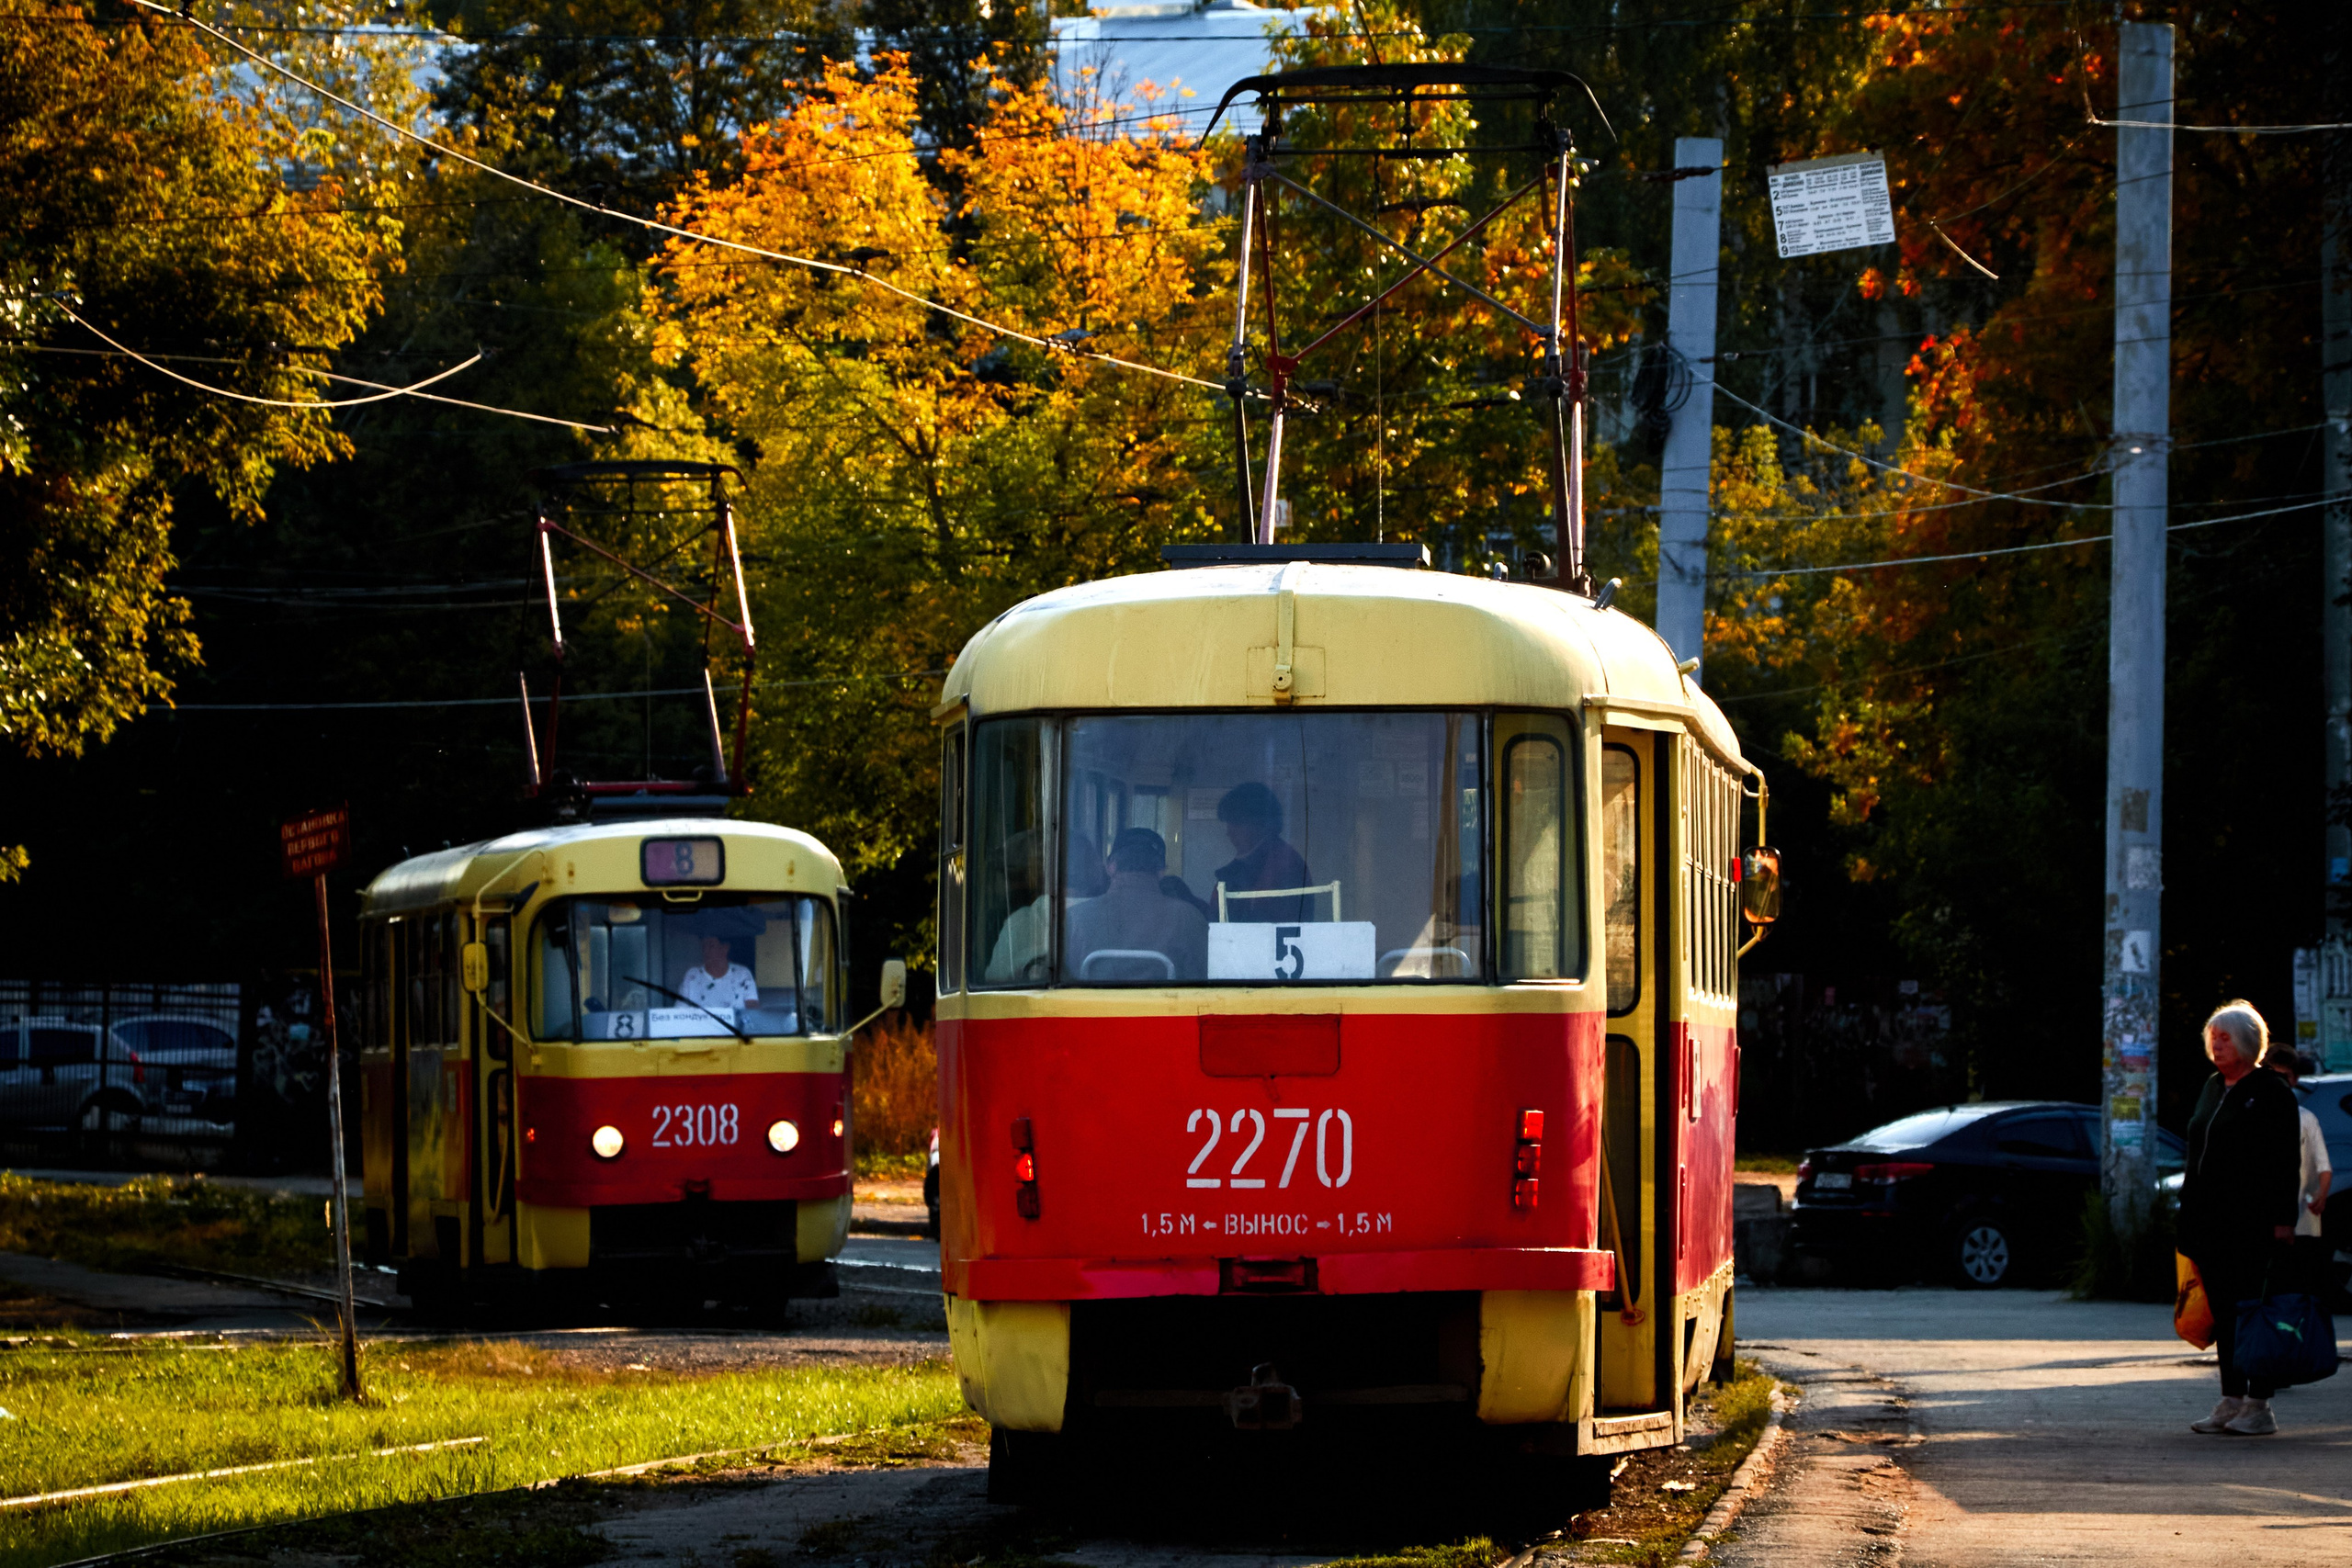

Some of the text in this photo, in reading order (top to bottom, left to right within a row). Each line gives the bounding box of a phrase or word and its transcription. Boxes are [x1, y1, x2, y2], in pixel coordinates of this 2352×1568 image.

[1772, 190, 1781, 200] 2
[1775, 206, 1783, 216] 5
[1777, 220, 1784, 231] 7
[1780, 233, 1787, 243] 8
[1781, 245, 1789, 255] 9
[675, 841, 695, 876] 8
[1275, 927, 1304, 979] 5
[651, 1013, 671, 1022] Без
[615, 1014, 634, 1038] 8
[652, 1103, 739, 1147] 2308
[1186, 1108, 1352, 1189] 2270
[1225, 1213, 1308, 1235] ВЫНОС
